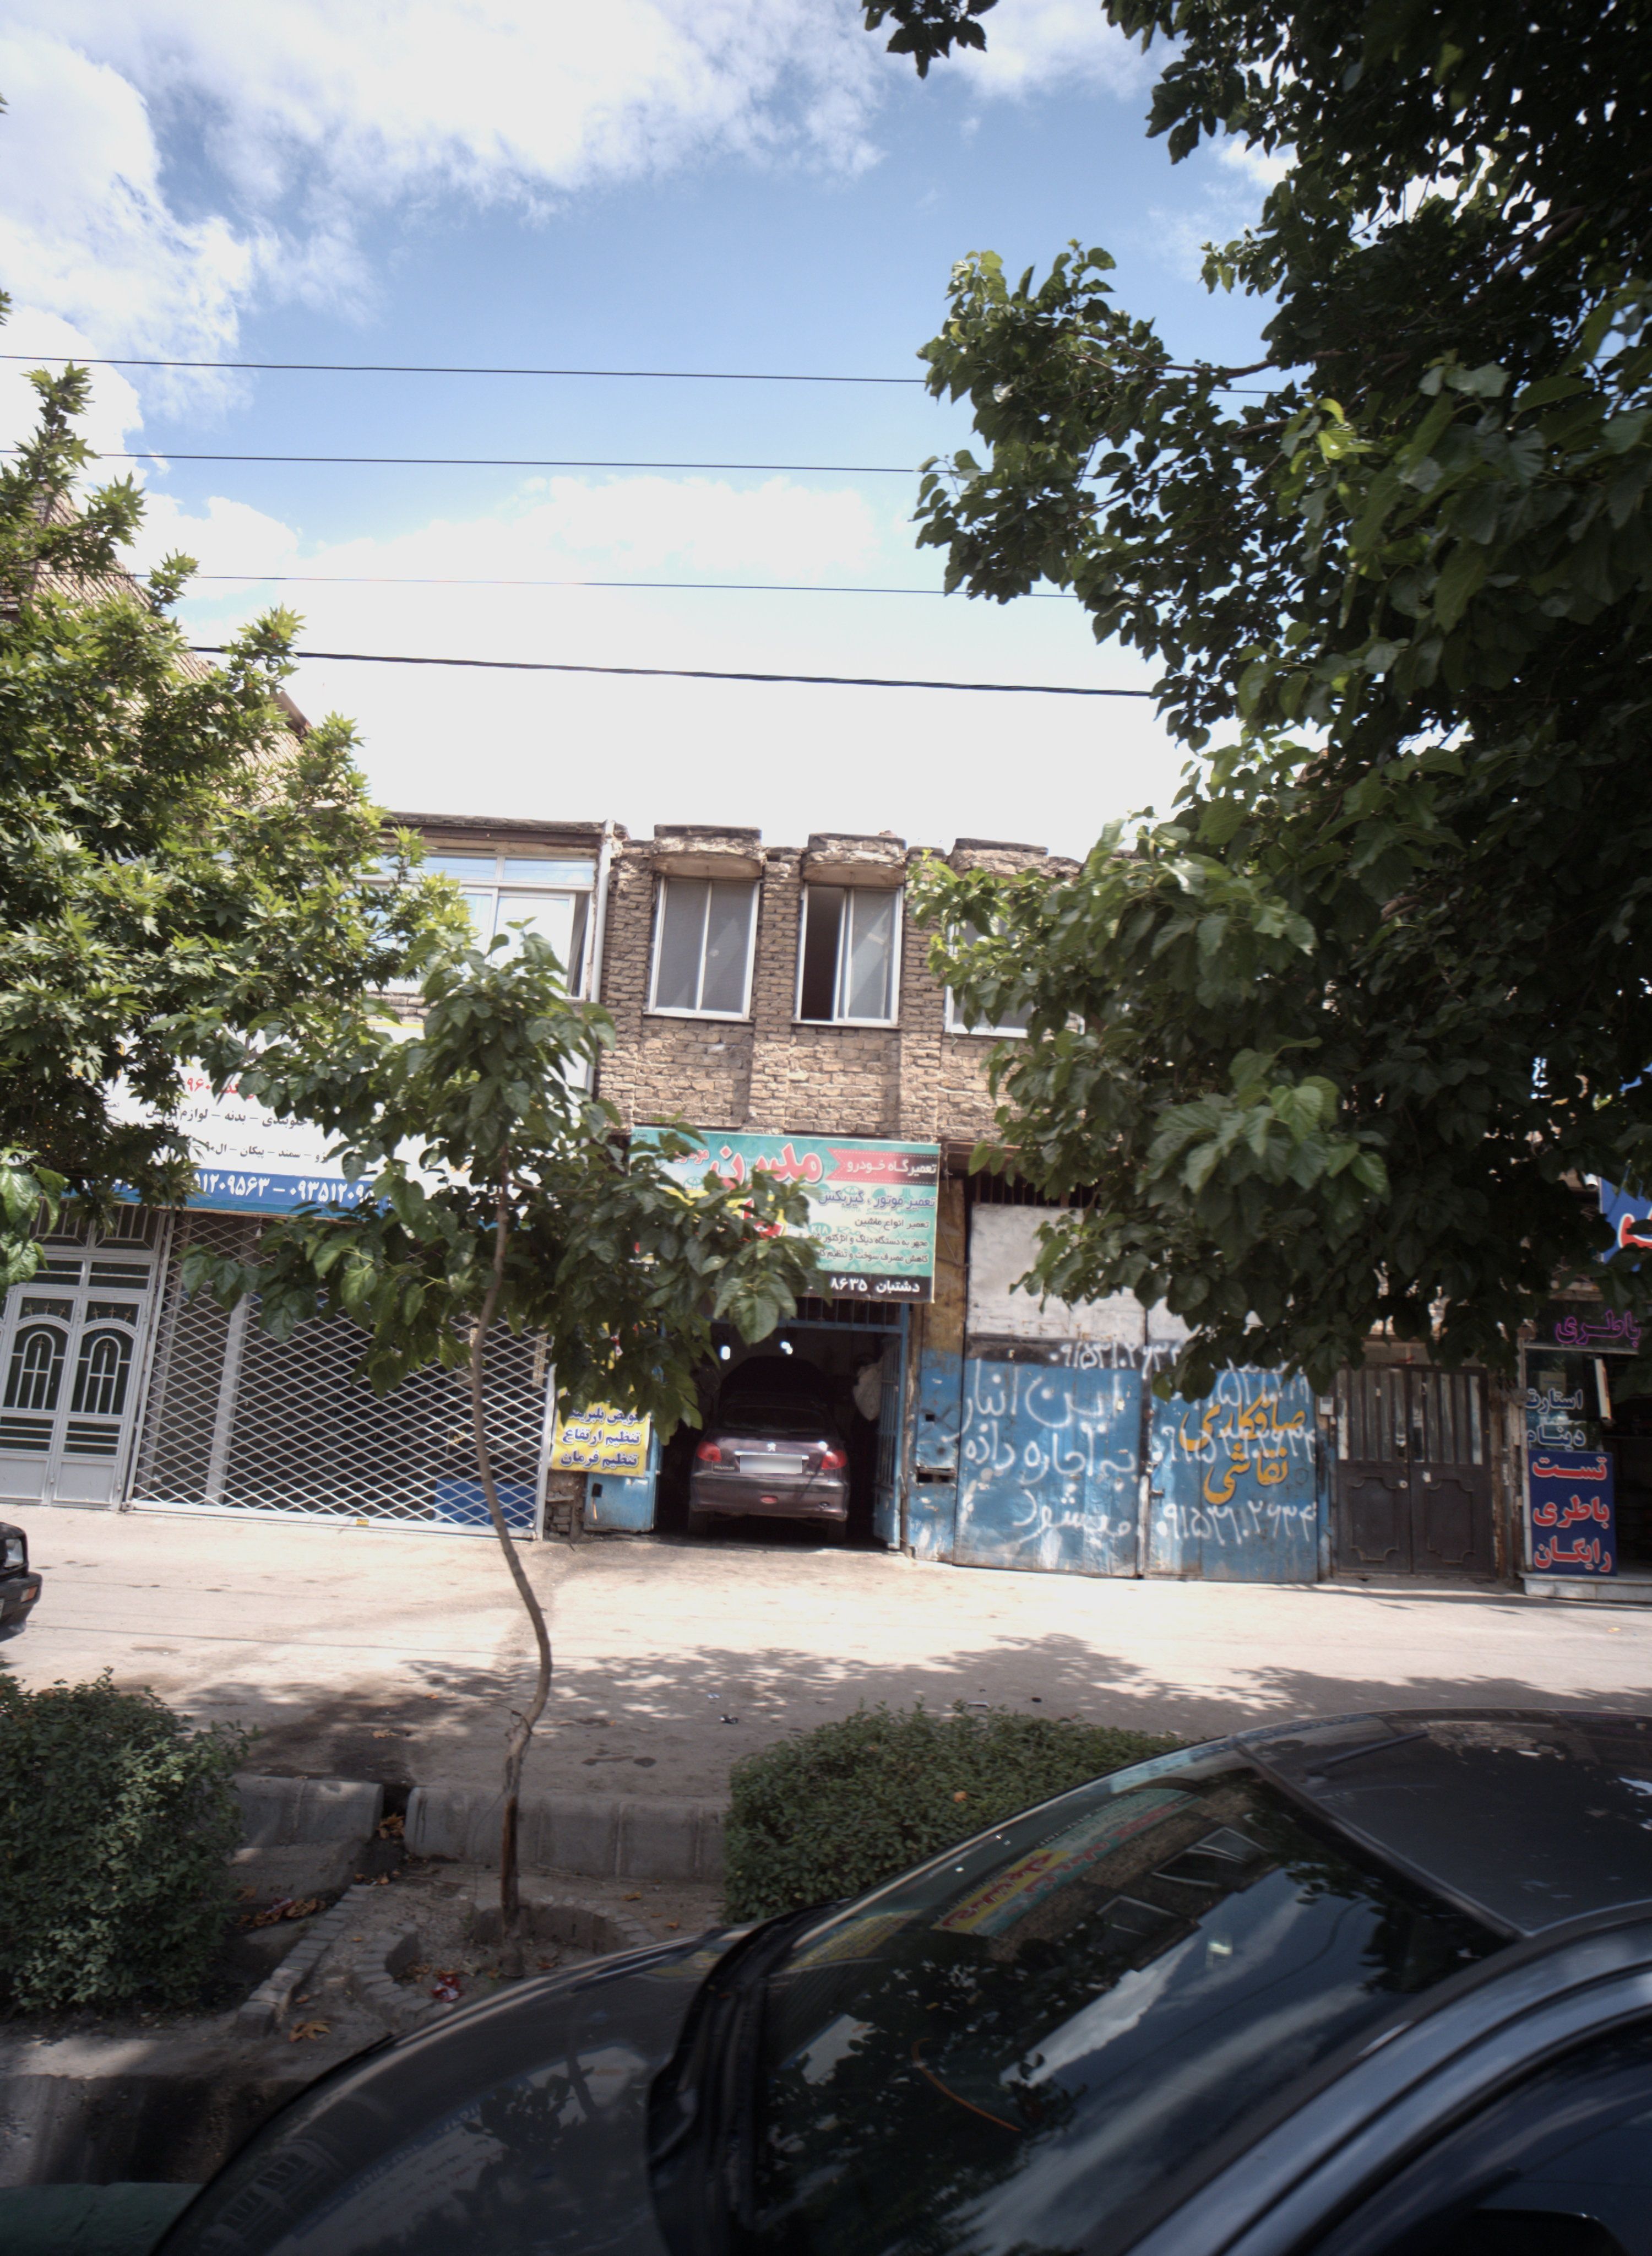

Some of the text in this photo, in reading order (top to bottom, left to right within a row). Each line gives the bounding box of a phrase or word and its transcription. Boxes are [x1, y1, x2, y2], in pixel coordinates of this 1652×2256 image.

[180, 1108, 208, 1122] لوازم
[225, 1110, 246, 1124] بدنه
[240, 1145, 264, 1159] پیکان
[279, 1149, 301, 1158] سمند
[847, 1159, 885, 1174] خودرو
[818, 1189, 865, 1207] گیربکس
[873, 1194, 904, 1209] موتور
[906, 1196, 937, 1210] تعمیر
[855, 1217, 882, 1227] ماشین
[884, 1219, 904, 1230] انواع
[874, 1235, 900, 1245] دستگاه
[901, 1240, 910, 1248] به
[911, 1239, 928, 1249] مجهز
[827, 1250, 847, 1259] تنظیم
[855, 1252, 879, 1261] سوخت
[881, 1253, 904, 1262] مصرف
[905, 1255, 928, 1265] کاهش
[830, 1277, 868, 1292] ۸۶۳۵
[1555, 1309, 1642, 1348] باطری
[1025, 1375, 1121, 1434] این
[1525, 1387, 1584, 1414] استارت
[562, 1428, 641, 1446] تنظیم ارتفاع
[1527, 1422, 1586, 1451] دینام
[561, 1450, 638, 1468] تنظیم فرمان
[1203, 1442, 1288, 1505] نقاشی
[1532, 1456, 1608, 1480] تست
[1533, 1494, 1610, 1530] باطری
[1534, 1534, 1612, 1573] رایگان
